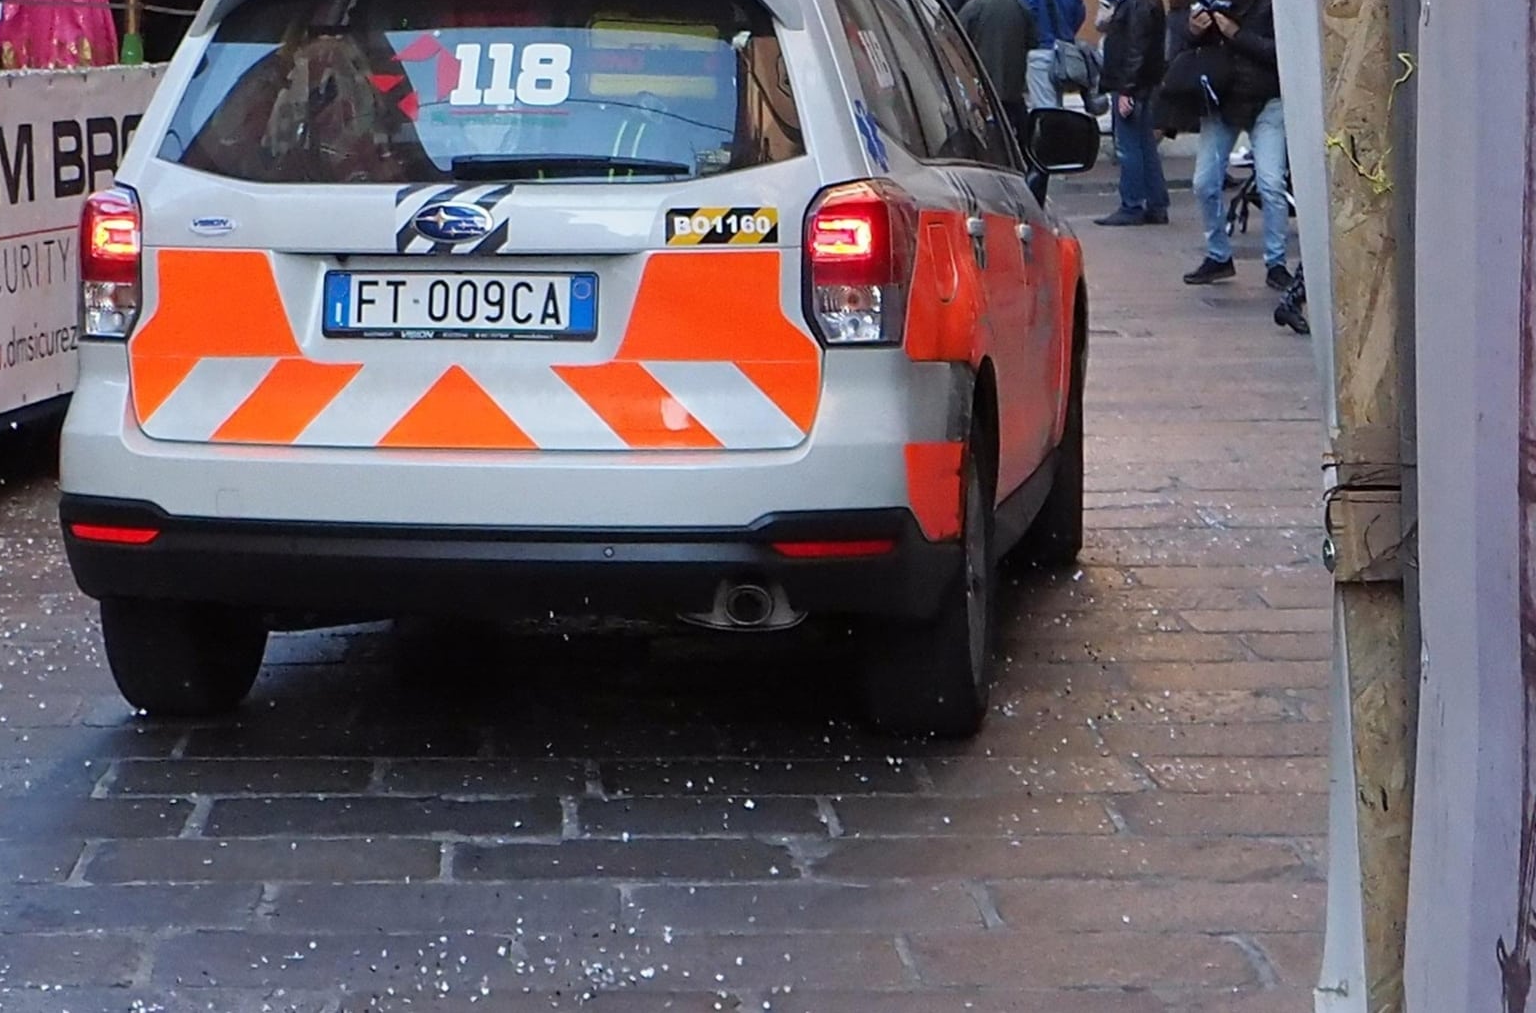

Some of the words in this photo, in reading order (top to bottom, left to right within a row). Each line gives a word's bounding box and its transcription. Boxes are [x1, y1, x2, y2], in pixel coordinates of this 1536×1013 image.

[449, 43, 572, 105] 118
[673, 214, 771, 235] BO1160
[400, 330, 435, 339] VISION
